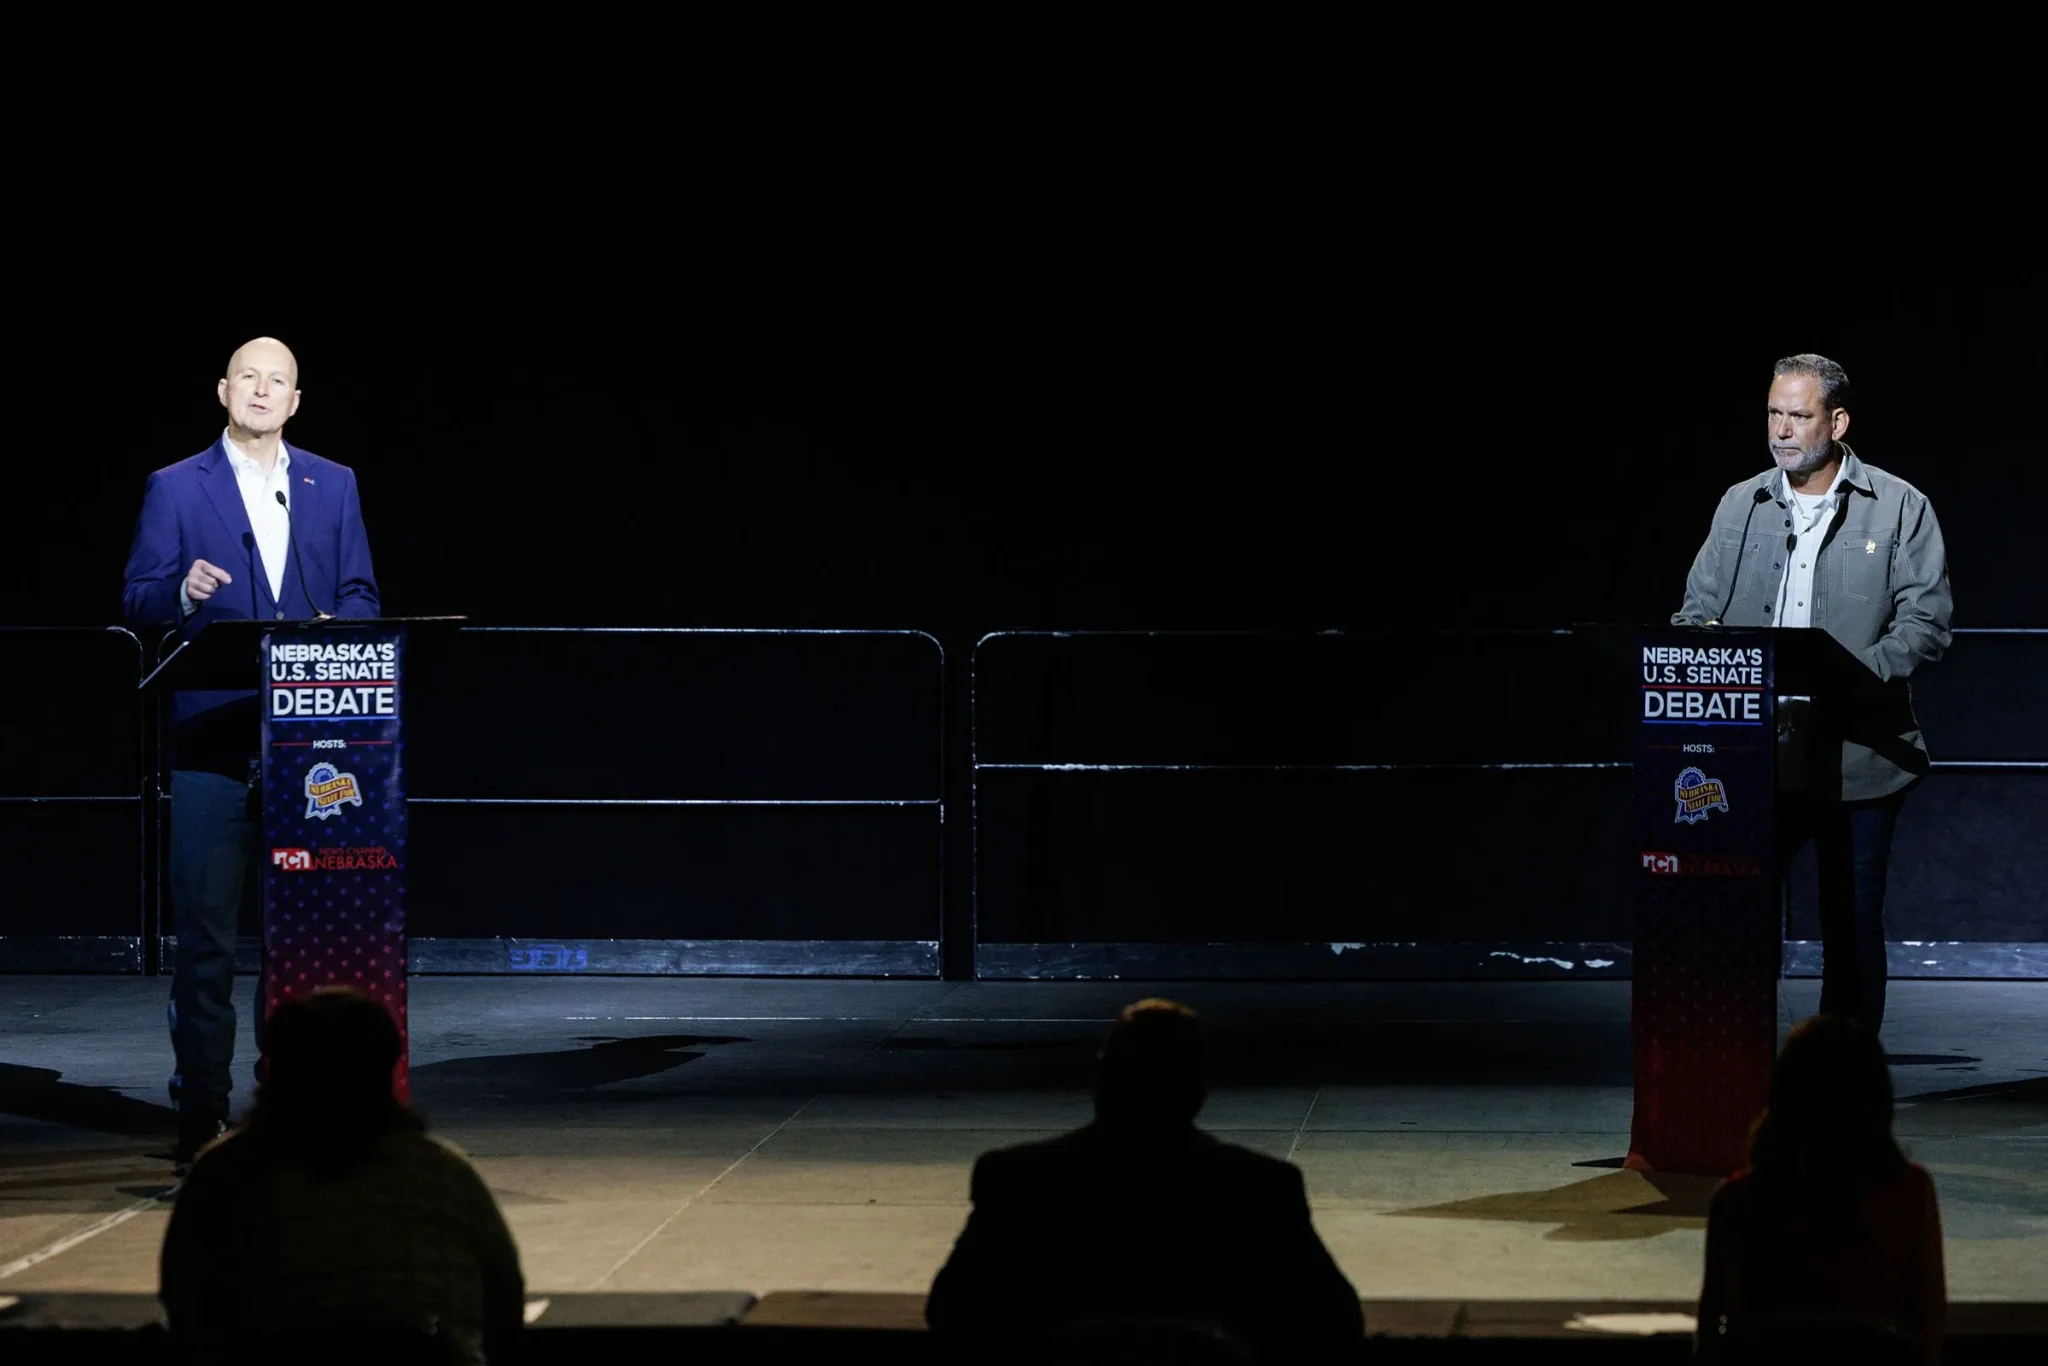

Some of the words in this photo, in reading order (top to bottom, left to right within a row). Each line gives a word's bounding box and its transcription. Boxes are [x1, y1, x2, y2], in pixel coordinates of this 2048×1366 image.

[270, 643, 395, 662] NEBRASKA'S
[1643, 647, 1763, 666] NEBRASKA'S
[271, 663, 311, 681] U.S.
[315, 662, 395, 681] SENATE
[1643, 665, 1682, 683] U.S.
[1686, 666, 1762, 685] SENATE
[272, 687, 395, 716] DEBATE
[1644, 691, 1761, 720] DEBATE
[312, 739, 347, 749] HOSTS:
[1682, 743, 1716, 754] HOSTS:
[1679, 783, 1719, 799] NEBRASKA
[313, 854, 398, 870] NEBRASKA
